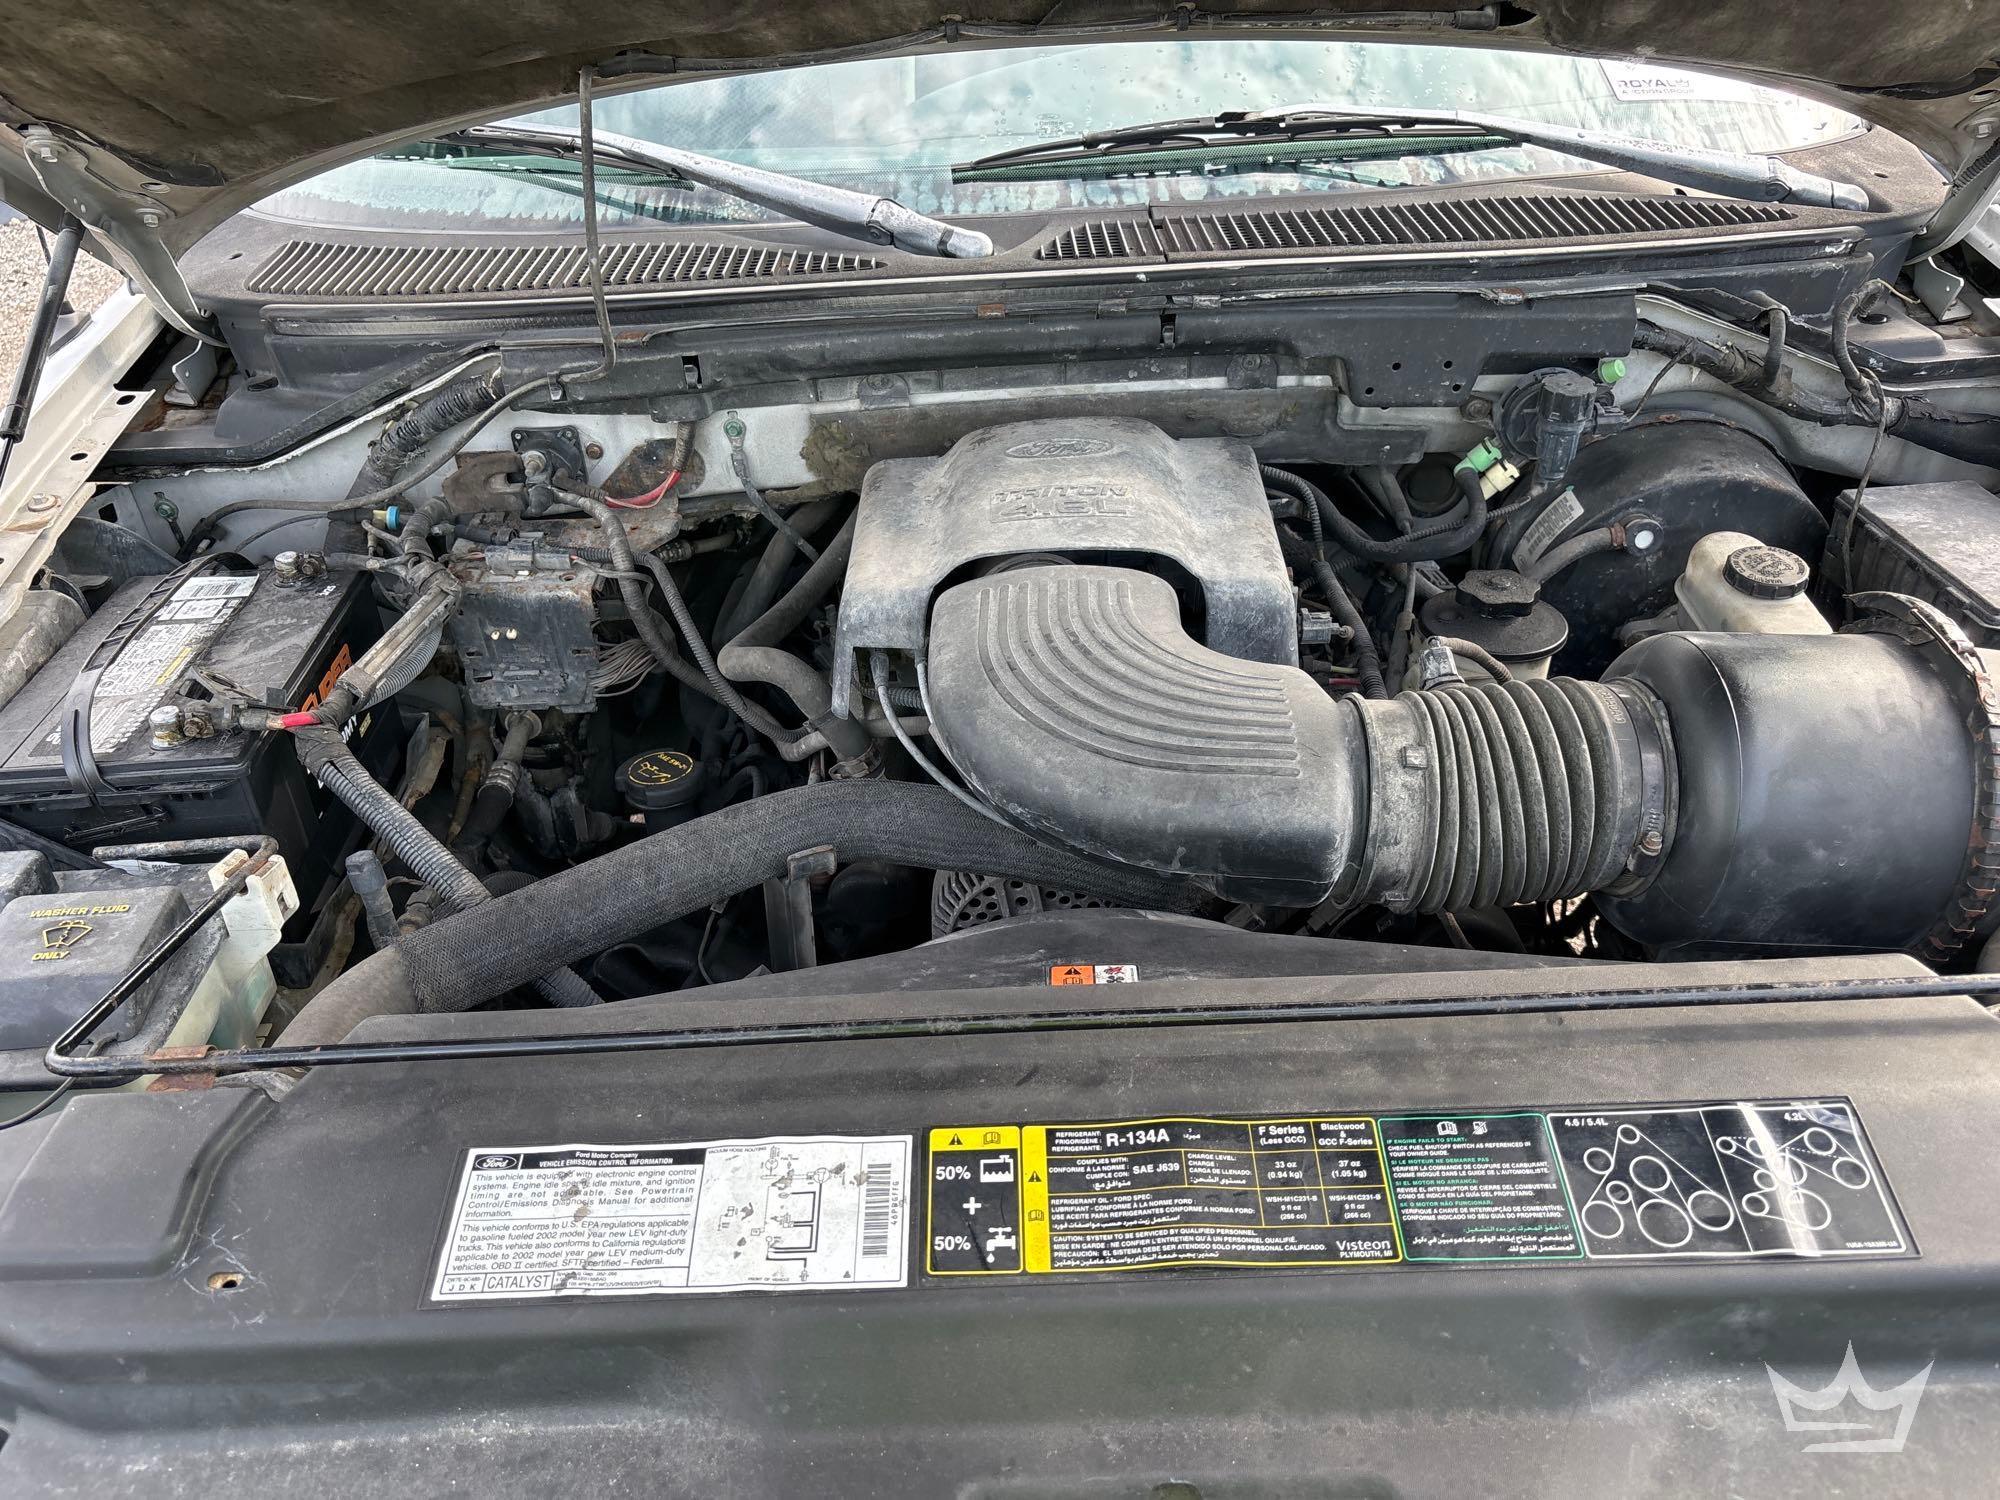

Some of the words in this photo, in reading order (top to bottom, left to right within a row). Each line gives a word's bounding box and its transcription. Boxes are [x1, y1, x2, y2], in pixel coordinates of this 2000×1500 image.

[30, 906, 89, 918] WASHER
[91, 904, 131, 914] FLUID
[31, 950, 71, 961] ONLY
[1258, 1126, 1266, 1135] F
[1269, 1125, 1305, 1135] Series
[1320, 1123, 1366, 1131] Blackwood
[1106, 1128, 1170, 1148] R-134A
[1260, 1137, 1283, 1146] (Less
[1284, 1135, 1307, 1145] GCC)
[1318, 1138, 1337, 1146] GCC
[1339, 1138, 1373, 1146] F-Series
[610, 1152, 639, 1160] Company
[1187, 1152, 1213, 1160] CHARGE
[566, 1159, 597, 1167] EMISSION
[1132, 1165, 1154, 1175] SAE
[1156, 1162, 1180, 1172] J639
[495, 1172, 524, 1180] vehicle
[526, 1172, 533, 1180] is
[576, 1170, 593, 1178] with
[596, 1169, 635, 1178] electronic
[638, 1170, 665, 1178] engine
[668, 1168, 697, 1176] control
[935, 1165, 972, 1181] 50%
[1085, 1172, 1113, 1180] CUMPLE
[1267, 1171, 1287, 1179] (0.94
[1288, 1170, 1303, 1179] kg)
[1331, 1170, 1353, 1178] (1.05
[1353, 1169, 1367, 1178] kg)
[472, 1182, 508, 1191] systems.
[512, 1181, 541, 1190] Engine
[544, 1181, 559, 1189] idle
[592, 1179, 607, 1187] idle
[610, 1179, 643, 1187] mixture,
[665, 1178, 695, 1187] ignition
[470, 1191, 500, 1201] timing
[641, 1187, 694, 1195] Powertrain
[467, 1199, 548, 1209] Control/Emissions
[552, 1198, 594, 1207] Diagnosis
[598, 1197, 631, 1205] Manual
[650, 1196, 693, 1204] additional
[1050, 1198, 1096, 1206] REFRIGERANT
[1113, 1195, 1133, 1203] FORD
[465, 1209, 513, 1218] information.
[462, 1223, 480, 1232] This
[482, 1223, 510, 1231] vehicle
[512, 1222, 550, 1231] conforms
[552, 1222, 560, 1230] to
[581, 1220, 599, 1229] EPA
[601, 1220, 645, 1230] regulations
[647, 1219, 689, 1229] applicable
[460, 1234, 468, 1242] to
[470, 1234, 506, 1243] gasoline
[508, 1232, 534, 1240] fueled
[536, 1231, 557, 1240] 2002
[559, 1230, 585, 1239] model
[587, 1231, 606, 1240] year
[629, 1229, 647, 1237] LEV
[649, 1228, 688, 1238] light-duty
[457, 1244, 484, 1252] trucks.
[486, 1243, 503, 1251] This
[505, 1242, 533, 1250] vehicle
[535, 1241, 551, 1249] also
[553, 1240, 590, 1248] conforms
[592, 1240, 600, 1248] to
[602, 1239, 640, 1248] California
[642, 1238, 686, 1247] regulations
[933, 1235, 972, 1251] 50%
[1336, 1240, 1391, 1251] Visteon
[454, 1252, 499, 1262] applicable
[501, 1252, 509, 1260] to
[512, 1251, 534, 1260] 2002
[536, 1250, 562, 1259] model
[565, 1250, 585, 1259] year
[608, 1249, 627, 1257] LEV
[629, 1248, 685, 1257] medium-duty
[1339, 1250, 1383, 1258] PLYMOUTH,
[452, 1262, 488, 1271] vehicles.
[490, 1261, 512, 1270] OBD
[513, 1261, 522, 1270] II
[588, 1258, 621, 1267] certified
[630, 1257, 664, 1266] Federal.
[449, 1284, 455, 1292] J
[470, 1283, 477, 1291] K
[487, 1275, 551, 1290] CATALYST
